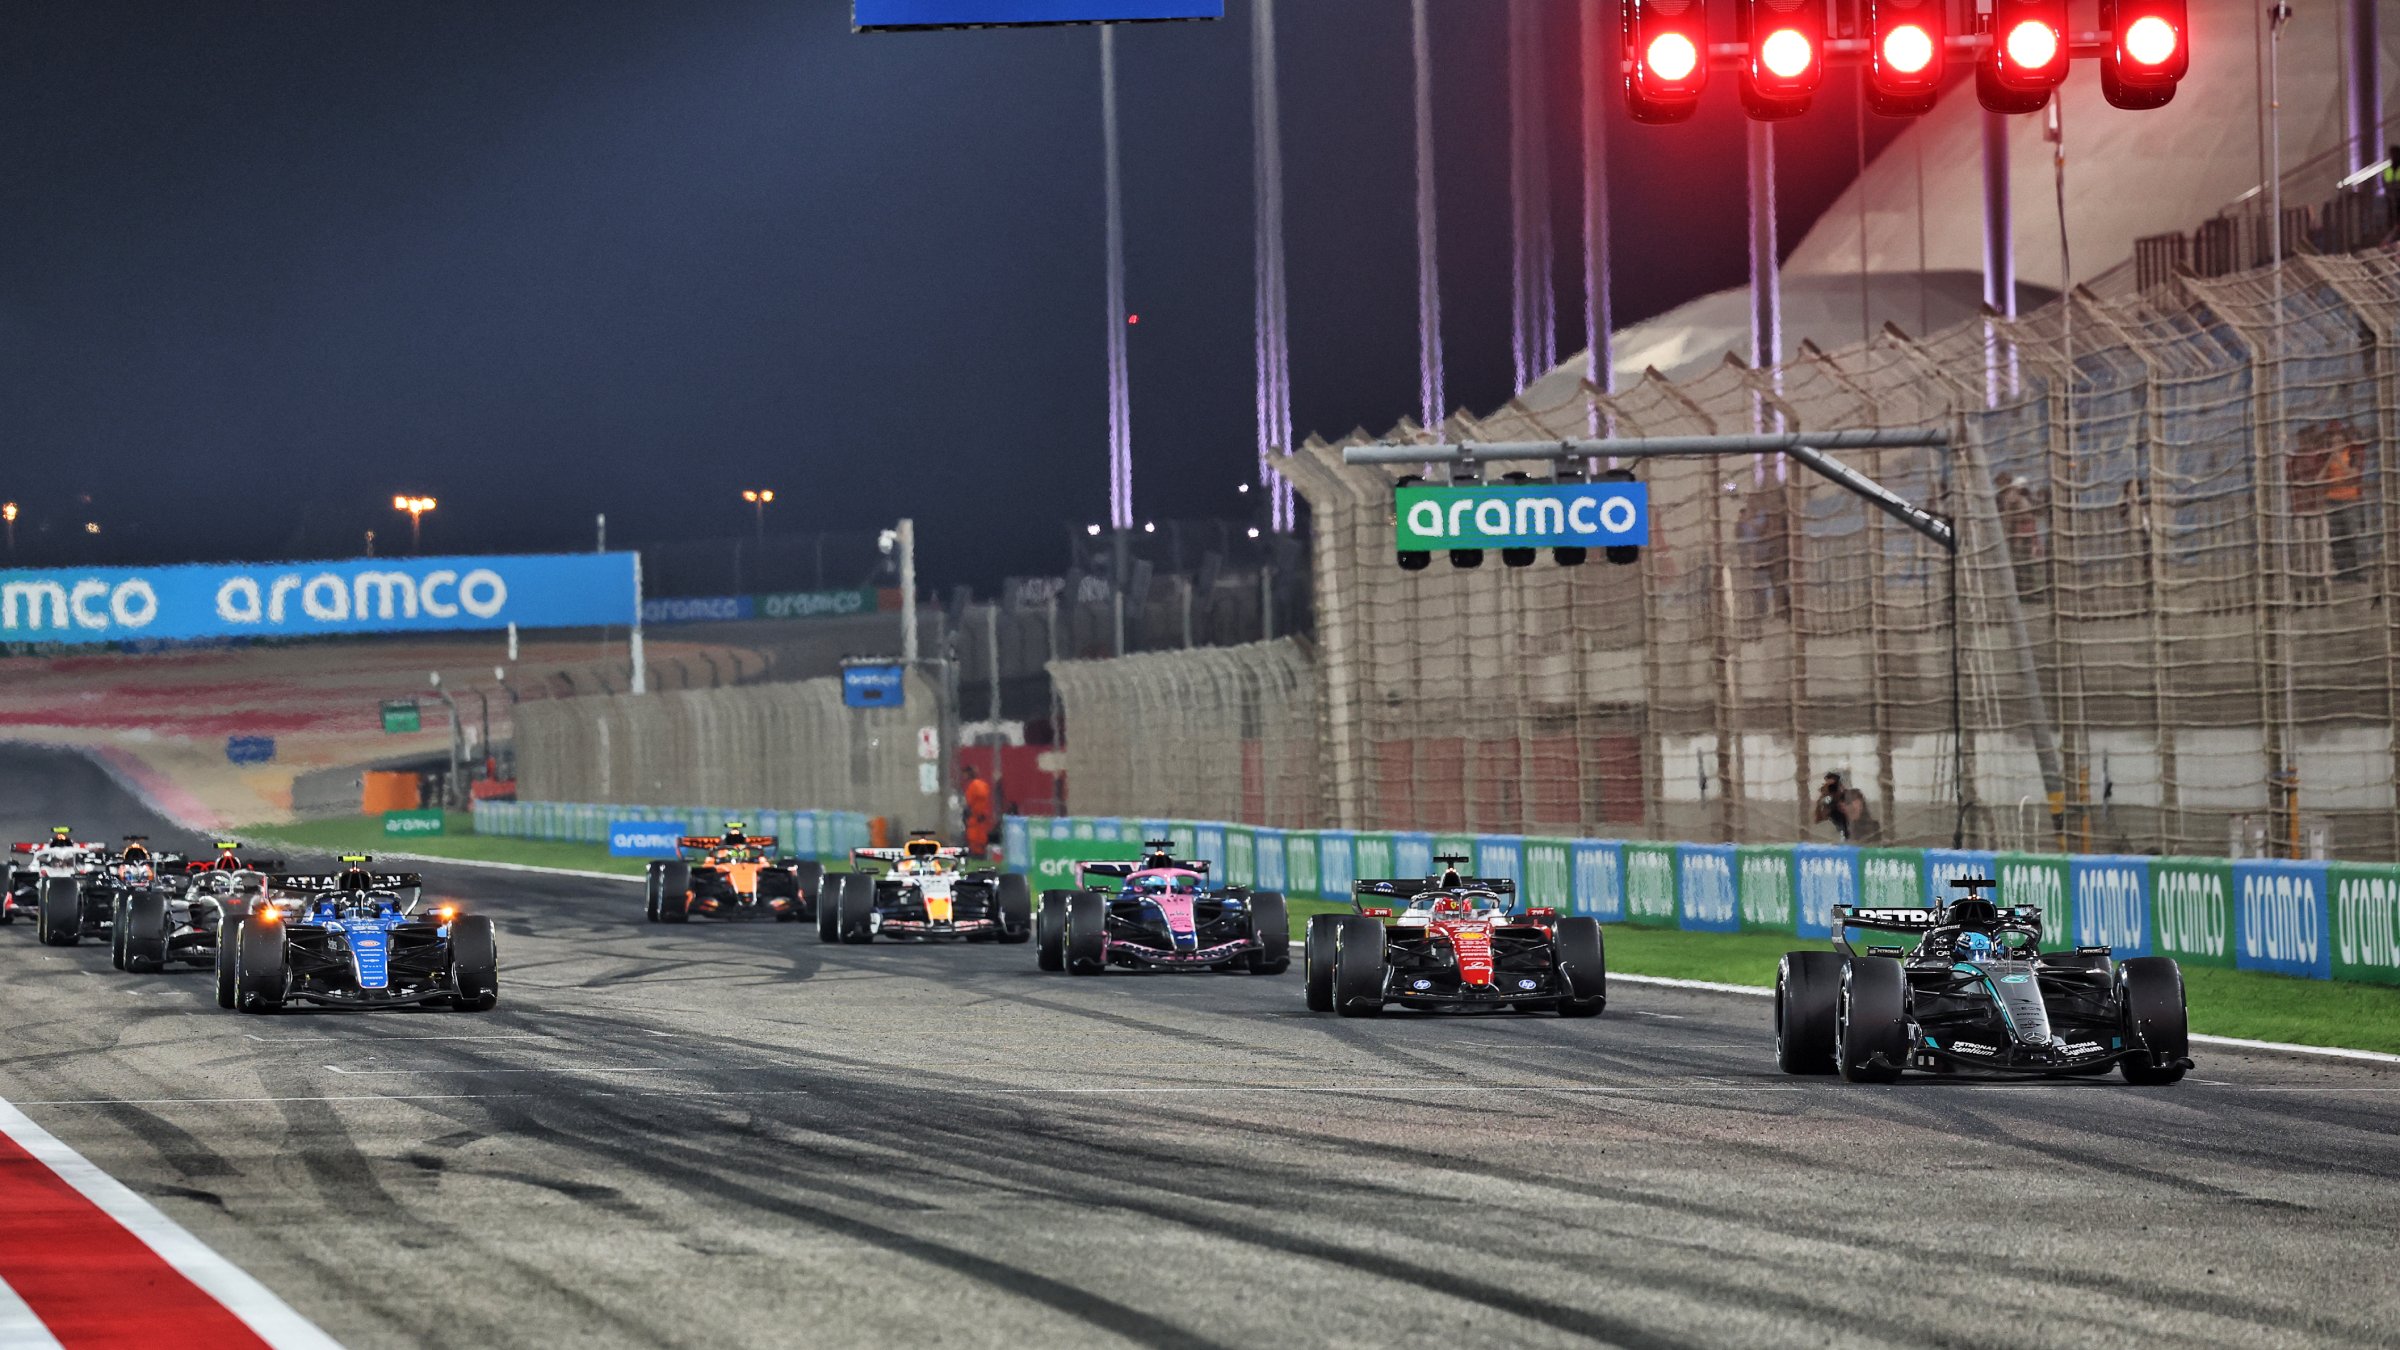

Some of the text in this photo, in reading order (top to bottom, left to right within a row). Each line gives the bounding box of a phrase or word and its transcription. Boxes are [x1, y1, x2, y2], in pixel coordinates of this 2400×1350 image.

[1407, 496, 1636, 537] aramco
[215, 568, 507, 624] aramco
[765, 592, 861, 617] aramco
[2079, 869, 2142, 949] aramco
[2158, 870, 2225, 957] aramco
[2244, 874, 2318, 964] aramco
[2338, 878, 2400, 968] aramc
[1954, 1041, 1997, 1051] PETRONAS
[2057, 1041, 2098, 1051] PETRONAS
